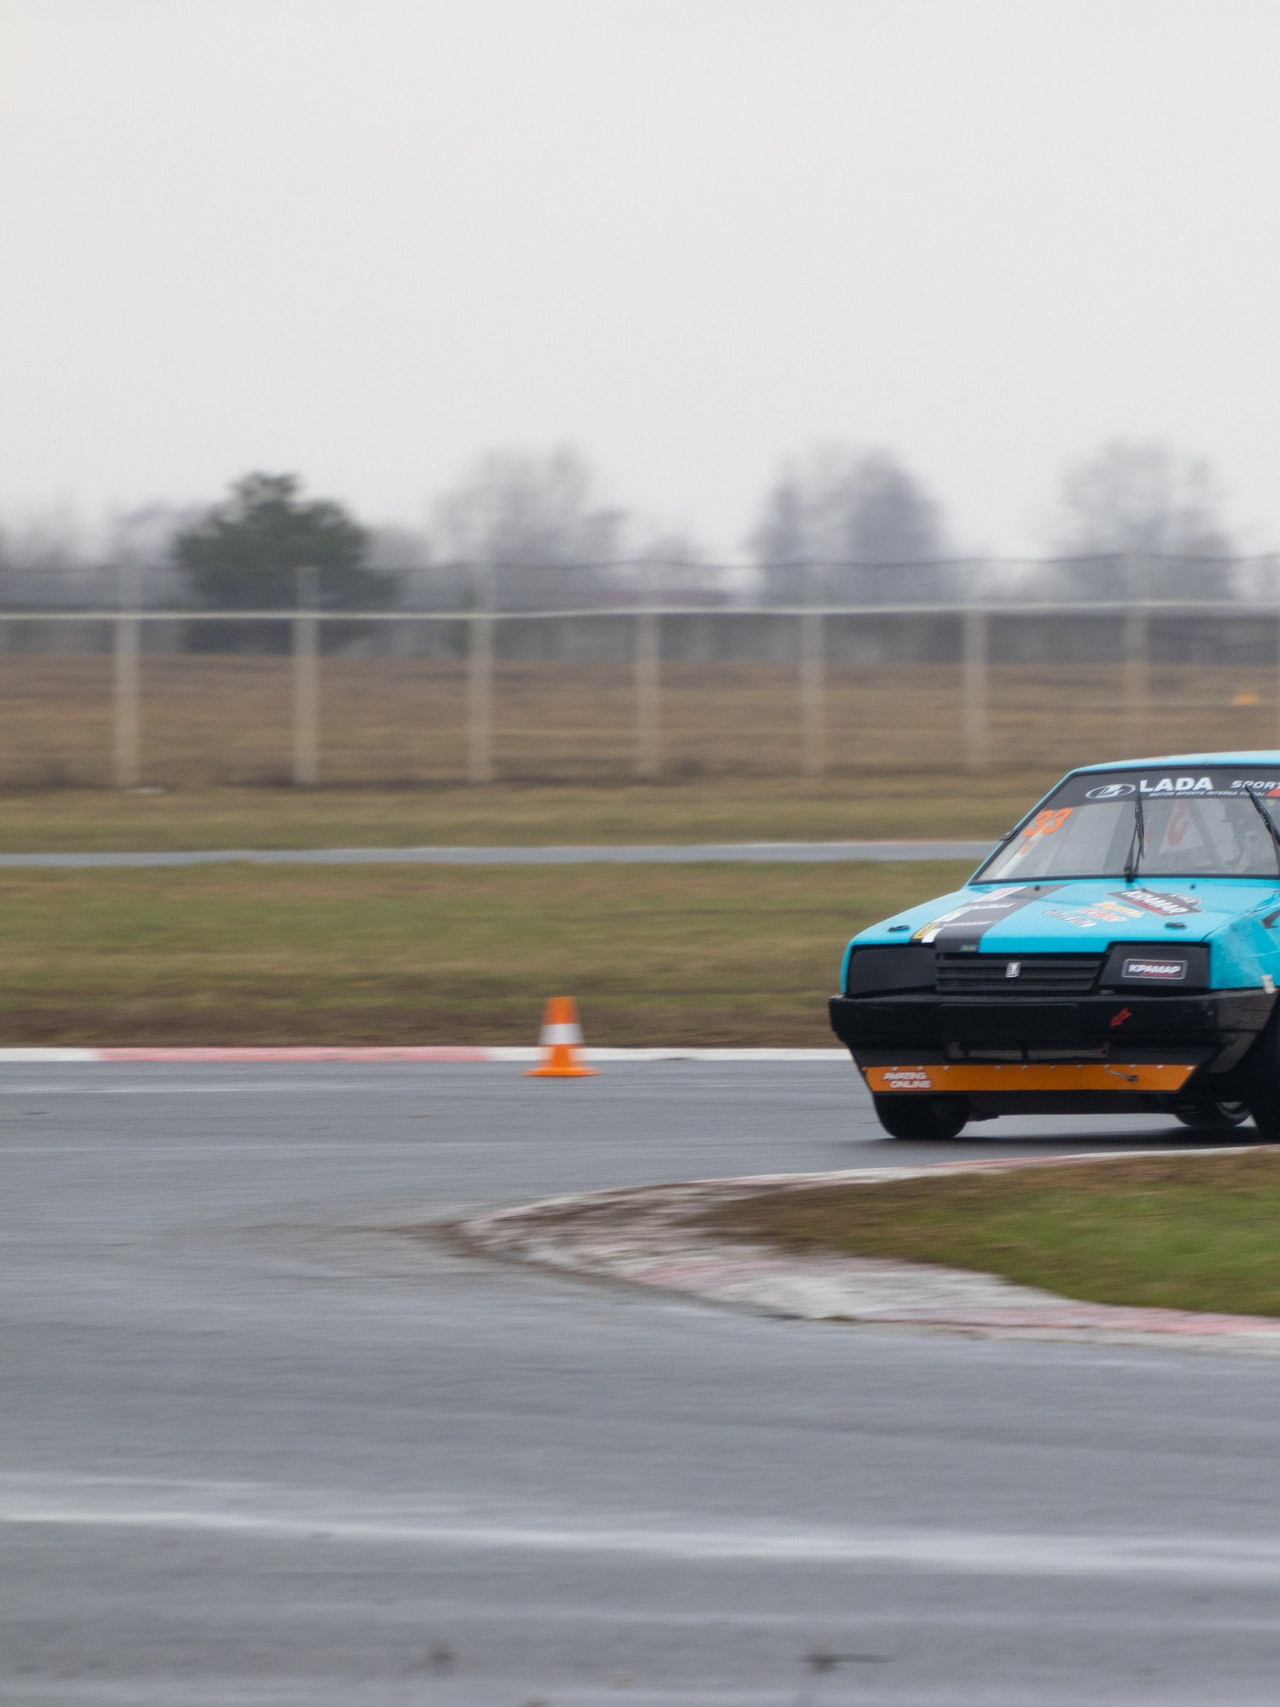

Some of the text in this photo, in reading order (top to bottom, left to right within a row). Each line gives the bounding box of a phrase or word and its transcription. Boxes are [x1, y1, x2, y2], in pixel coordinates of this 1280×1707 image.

[1139, 777, 1214, 793] LADA
[1023, 807, 1074, 838] 33
[883, 1072, 927, 1080] AMAZING
[889, 1080, 932, 1089] ONLINE
